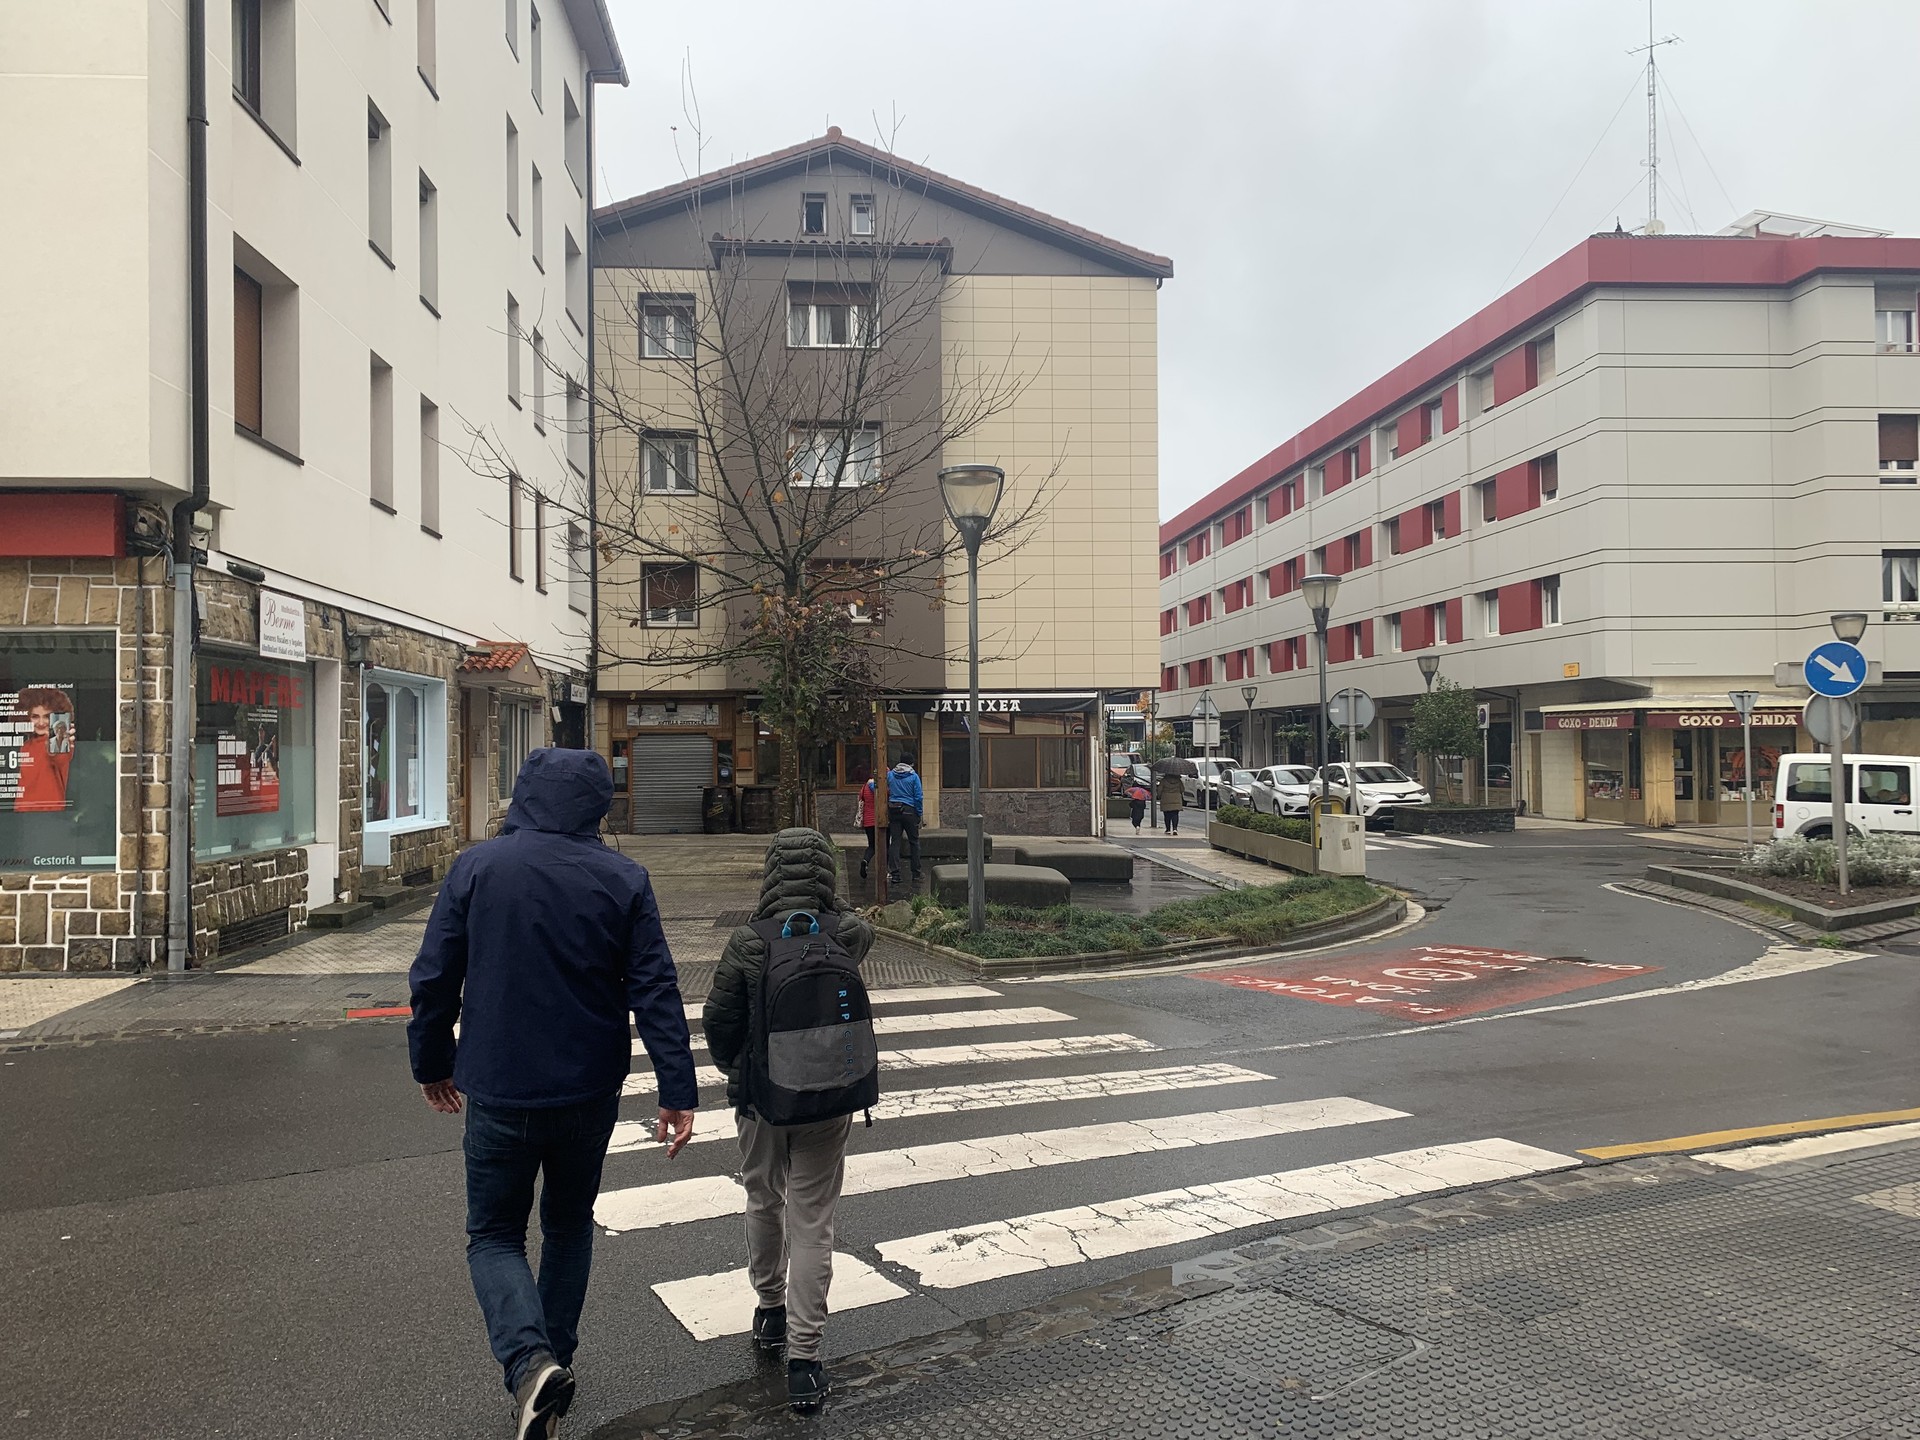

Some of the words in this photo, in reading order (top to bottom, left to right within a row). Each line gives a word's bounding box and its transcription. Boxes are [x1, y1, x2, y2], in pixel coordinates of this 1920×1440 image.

[264, 597, 295, 631] Berme
[210, 664, 304, 710] MAPFRE
[1558, 718, 1581, 729] GOXO
[1588, 717, 1618, 728] DENDA
[1678, 715, 1724, 727] GOXO
[8, 751, 17, 769] 6
[33, 855, 75, 865] Gestoría
[838, 990, 850, 1020] RIP
[843, 1030, 857, 1078] CURL
